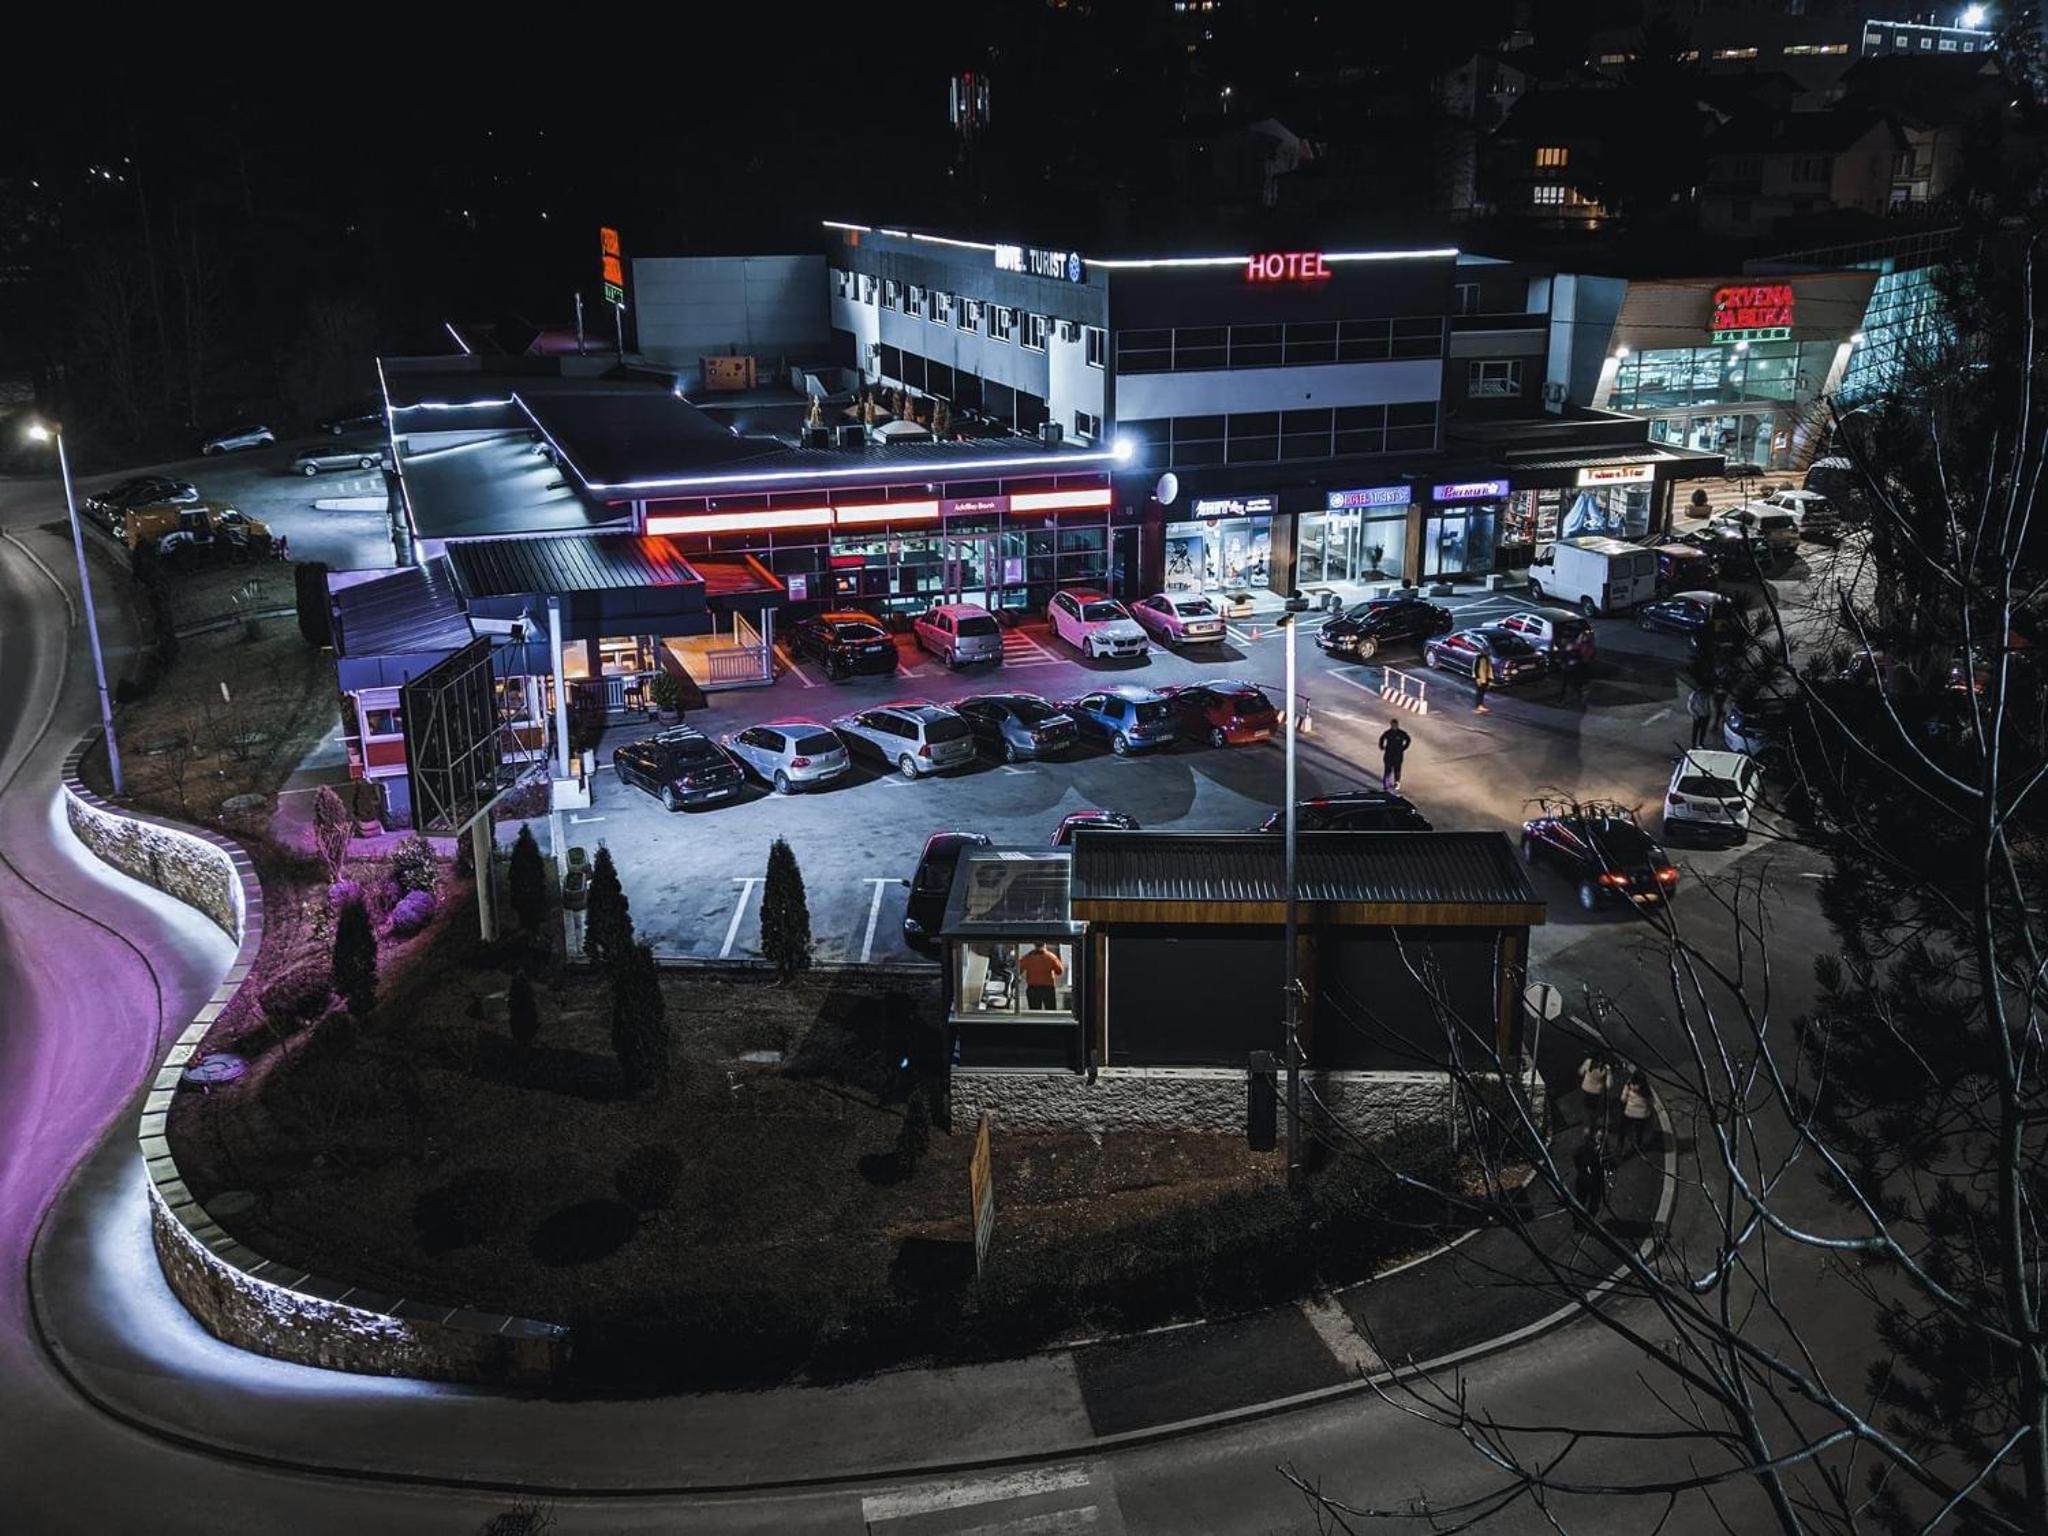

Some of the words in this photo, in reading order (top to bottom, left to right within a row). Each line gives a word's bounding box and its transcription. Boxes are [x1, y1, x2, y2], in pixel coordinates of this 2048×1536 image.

[995, 244, 1026, 271] HOTEL
[1029, 249, 1067, 278] TURIST
[1247, 252, 1330, 281] HOTEL
[1714, 286, 1792, 308] CRVENA
[1714, 329, 1791, 341] MARKET
